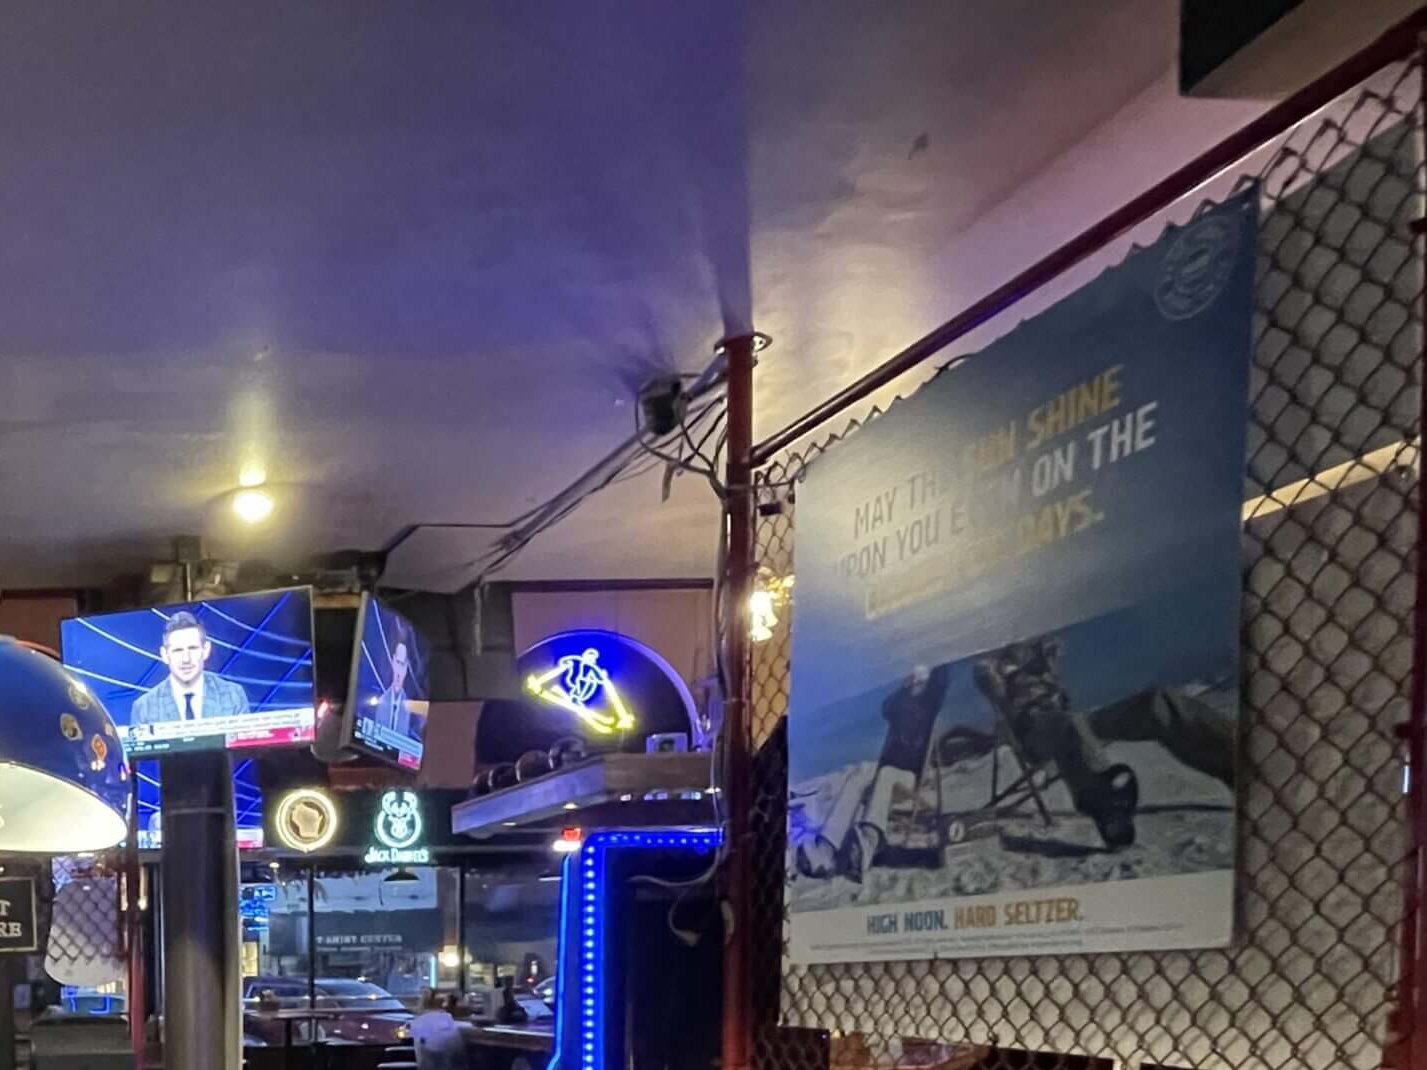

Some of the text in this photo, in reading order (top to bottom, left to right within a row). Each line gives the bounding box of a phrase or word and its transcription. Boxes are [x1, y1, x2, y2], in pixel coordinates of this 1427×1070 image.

[853, 486, 897, 540] MAY
[1026, 364, 1125, 449] SHINE
[896, 510, 941, 558] YOU
[1031, 442, 1077, 497] ON
[1086, 401, 1159, 471] THE
[866, 897, 1085, 935] HIGH NOON. HARD SELTZER.
